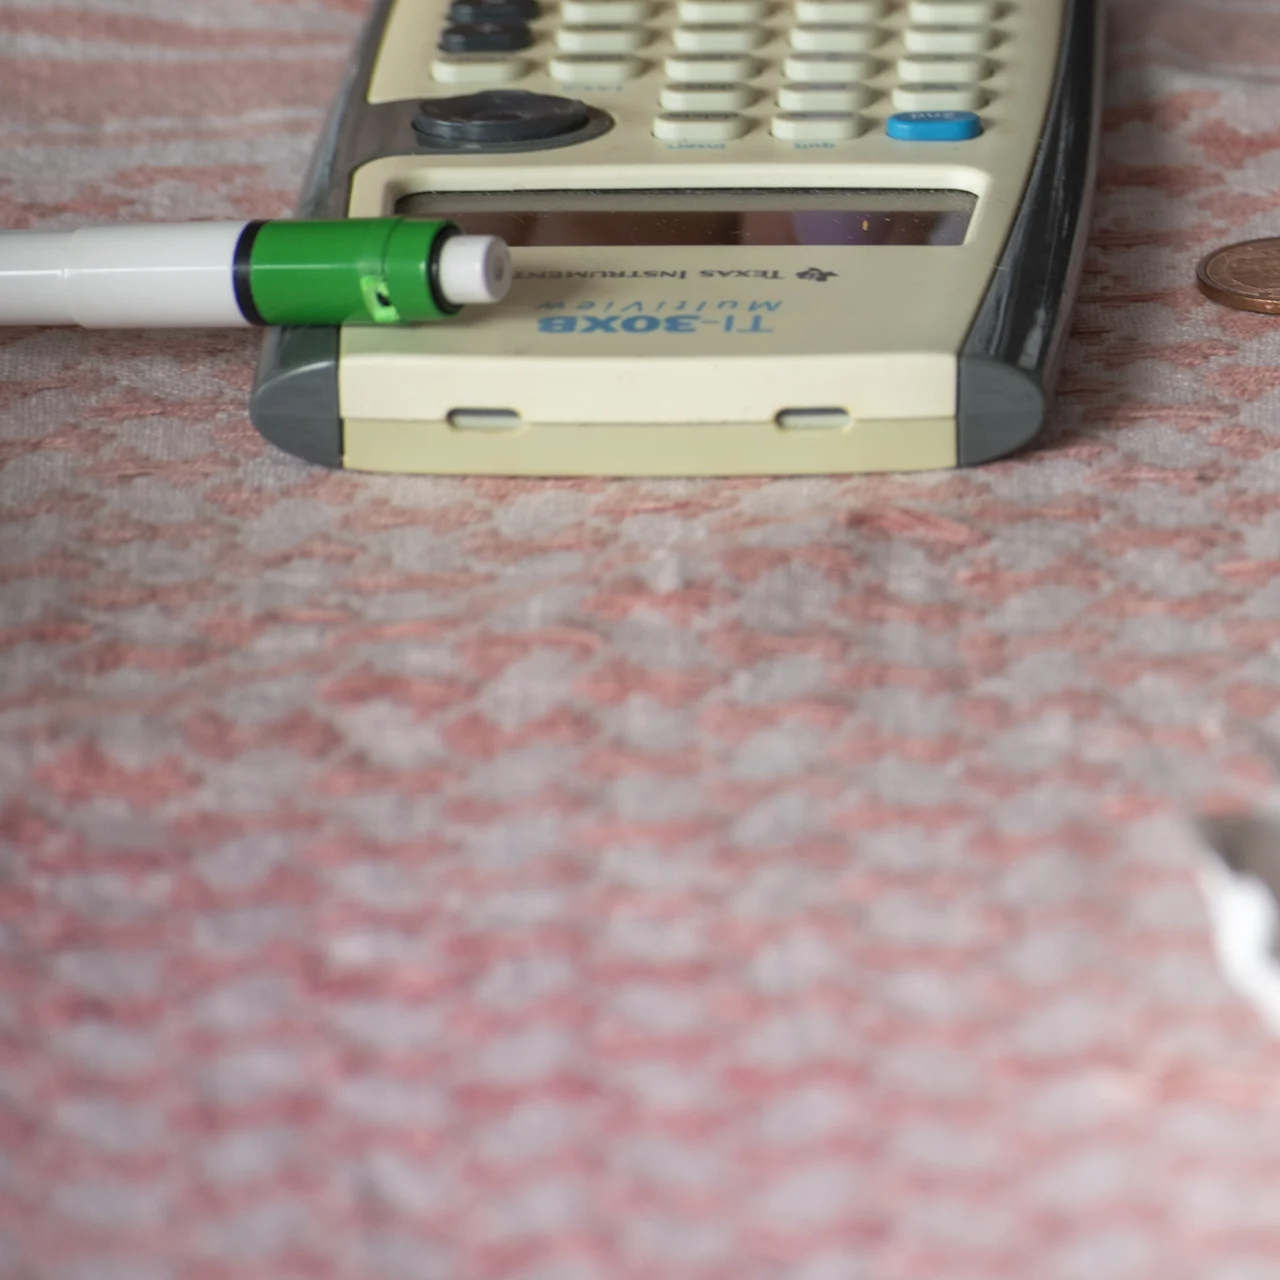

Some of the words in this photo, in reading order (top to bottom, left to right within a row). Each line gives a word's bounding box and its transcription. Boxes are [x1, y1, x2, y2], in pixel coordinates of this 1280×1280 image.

[513, 269, 687, 280] INSTRUMENT
[699, 269, 786, 280] TEXAS
[536, 299, 783, 313] MultiView
[536, 314, 774, 334] TI-30XB
